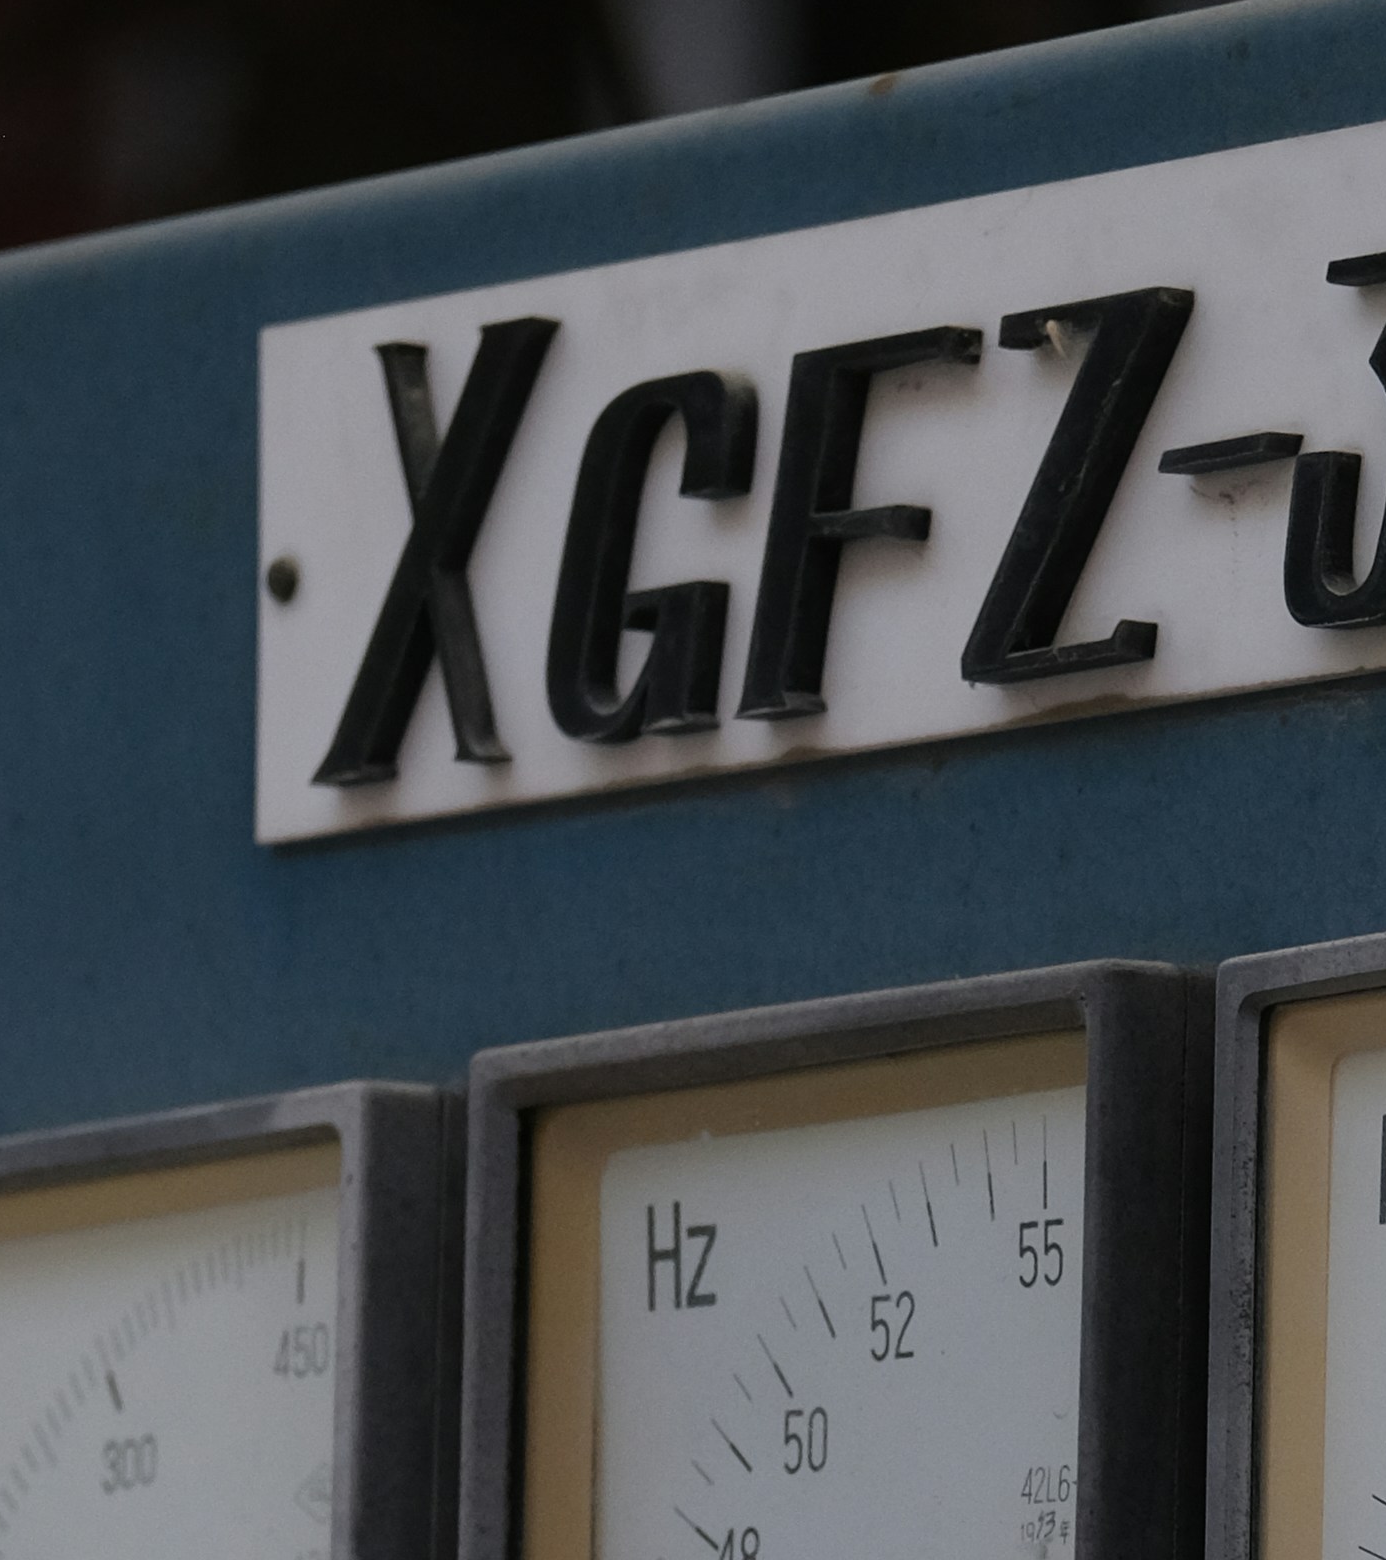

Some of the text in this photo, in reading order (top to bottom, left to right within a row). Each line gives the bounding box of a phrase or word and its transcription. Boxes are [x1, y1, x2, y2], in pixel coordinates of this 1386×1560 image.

[645, 1200, 719, 1312] Hz
[1017, 1217, 1066, 1290] 55
[273, 1320, 331, 1381] 450
[868, 1291, 917, 1363] 52
[100, 1433, 159, 1497] 300
[782, 1405, 830, 1476] 50
